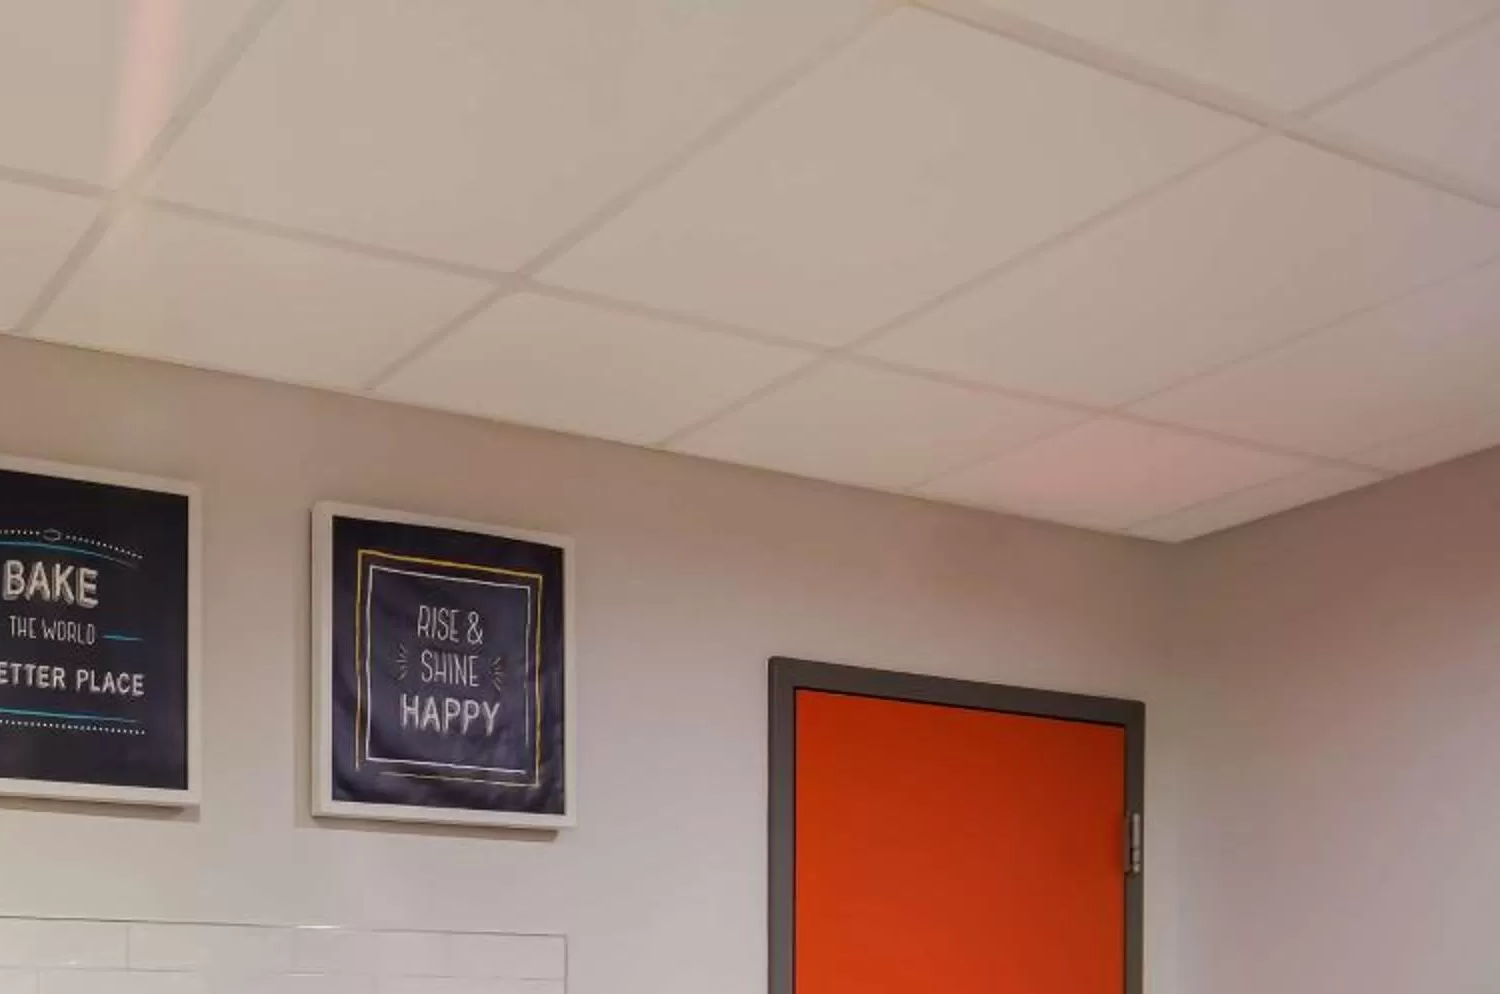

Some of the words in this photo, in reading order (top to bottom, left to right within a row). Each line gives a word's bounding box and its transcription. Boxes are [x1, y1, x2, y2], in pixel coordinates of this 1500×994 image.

[2, 559, 99, 609] BAKE
[9, 615, 37, 640] THE
[41, 618, 96, 645] WORLD
[417, 604, 460, 643] RISE
[467, 610, 484, 645] &
[76, 668, 145, 696] PLACE
[420, 649, 479, 687] SHINE
[400, 693, 500, 736] HAPPY
